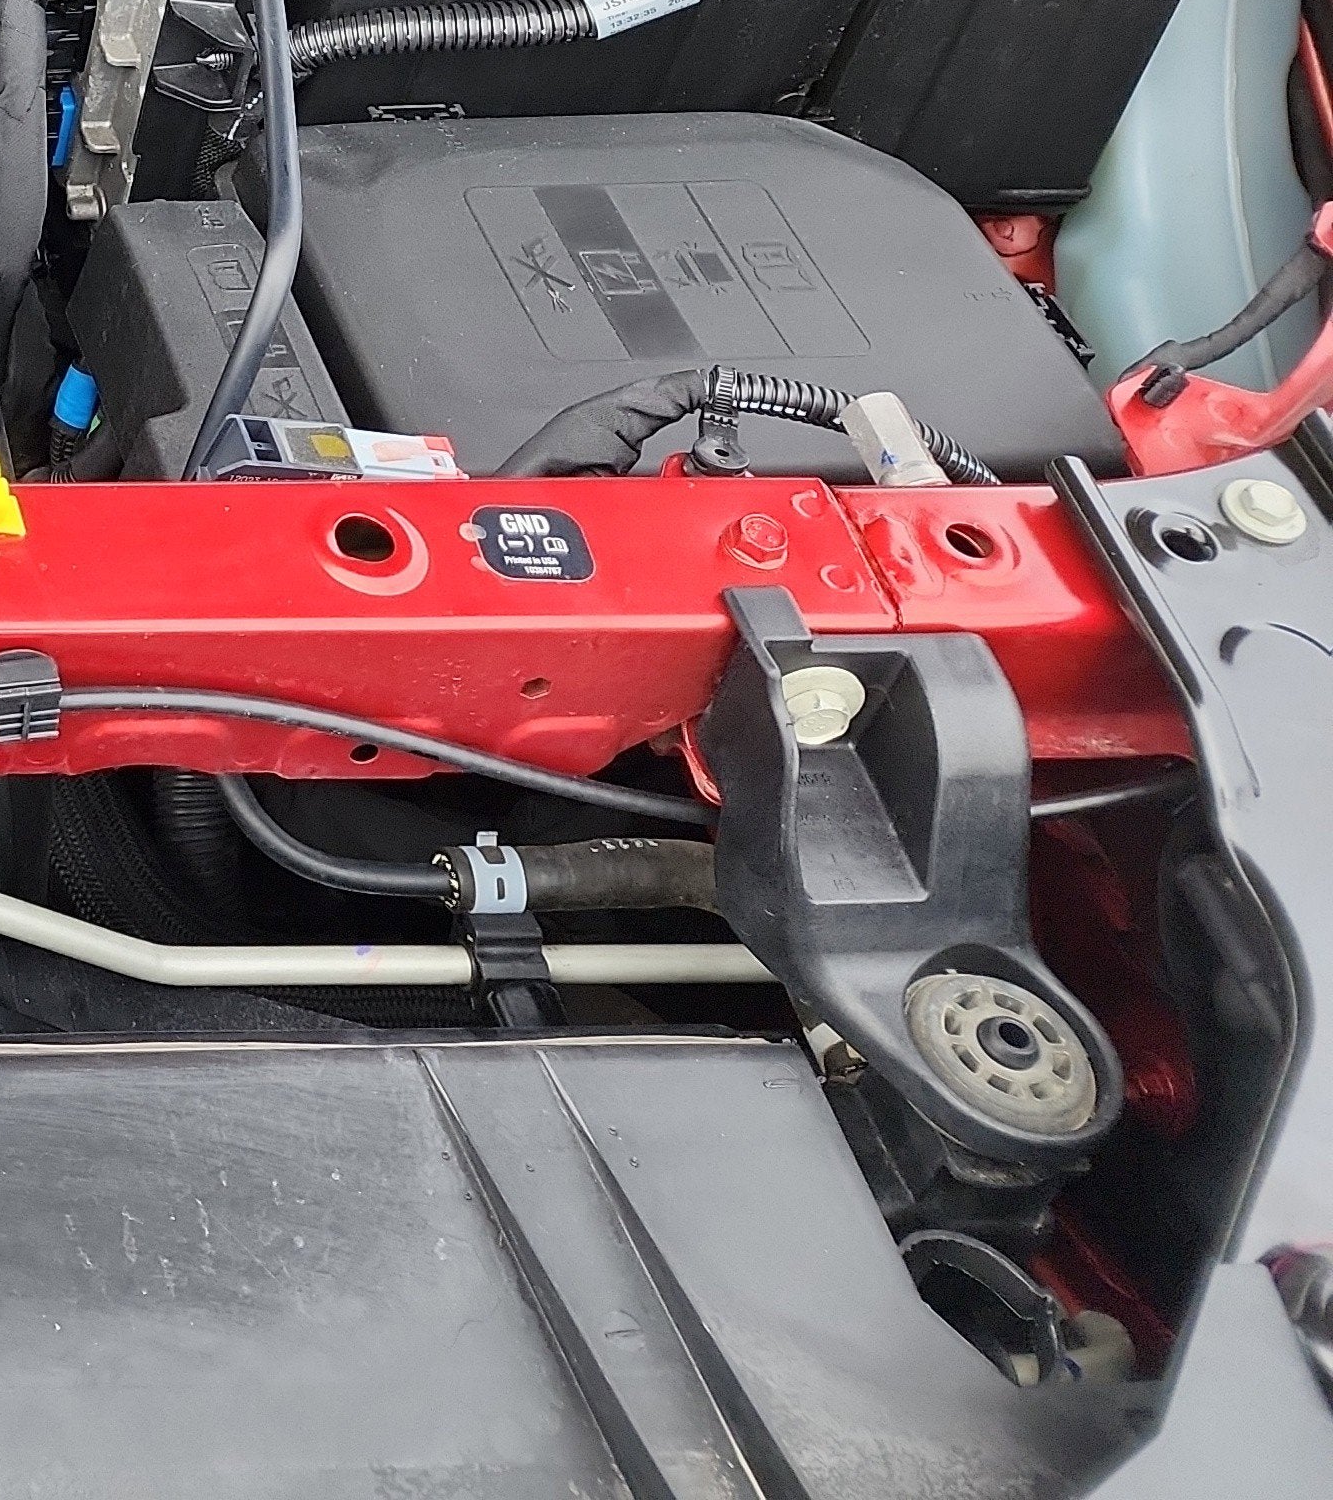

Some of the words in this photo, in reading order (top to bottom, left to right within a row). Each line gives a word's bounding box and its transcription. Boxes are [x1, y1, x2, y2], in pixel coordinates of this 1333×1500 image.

[499, 513, 551, 536] GND
[503, 555, 532, 565] Printed
[532, 556, 541, 565] in
[541, 556, 560, 566] USA
